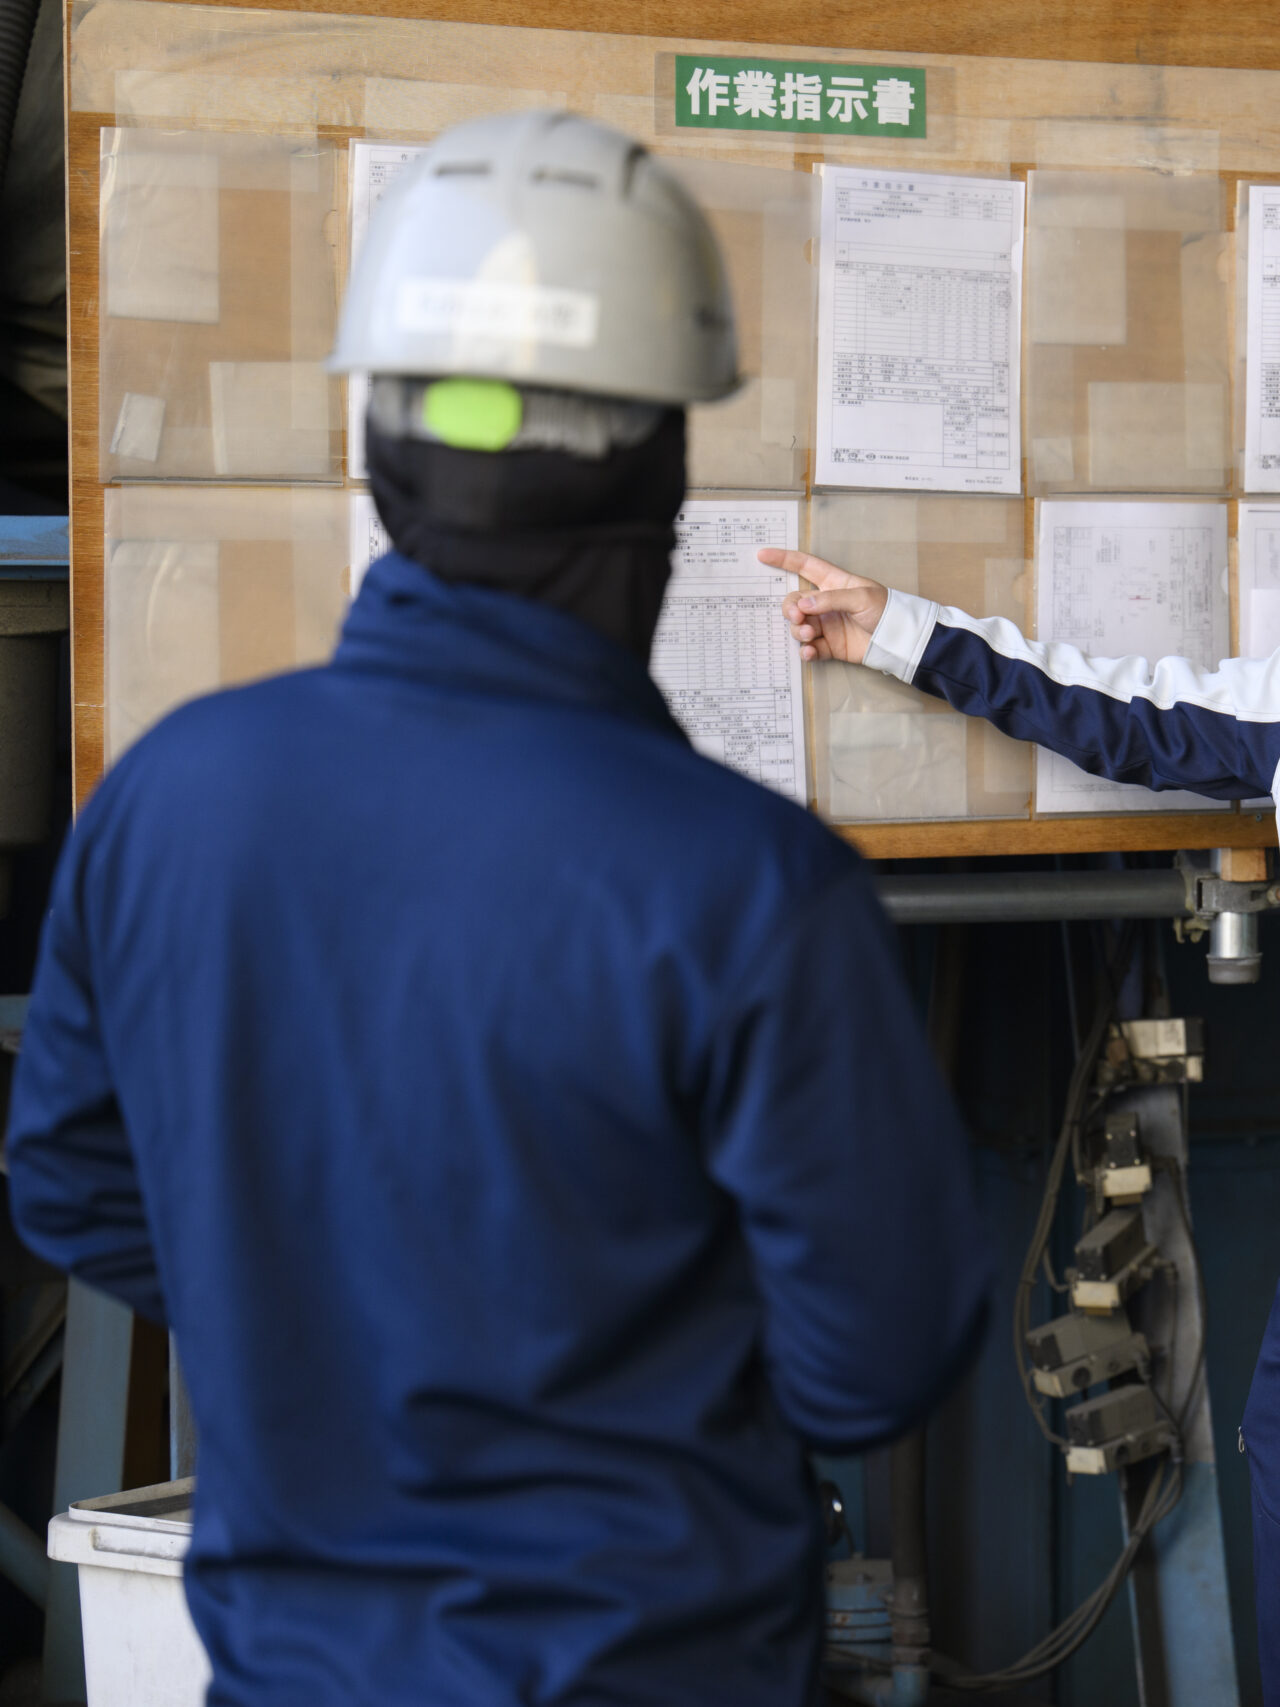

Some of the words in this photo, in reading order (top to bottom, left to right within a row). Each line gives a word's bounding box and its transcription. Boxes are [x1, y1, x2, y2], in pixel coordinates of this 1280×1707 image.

[686, 68, 915, 126] 作業指示書
